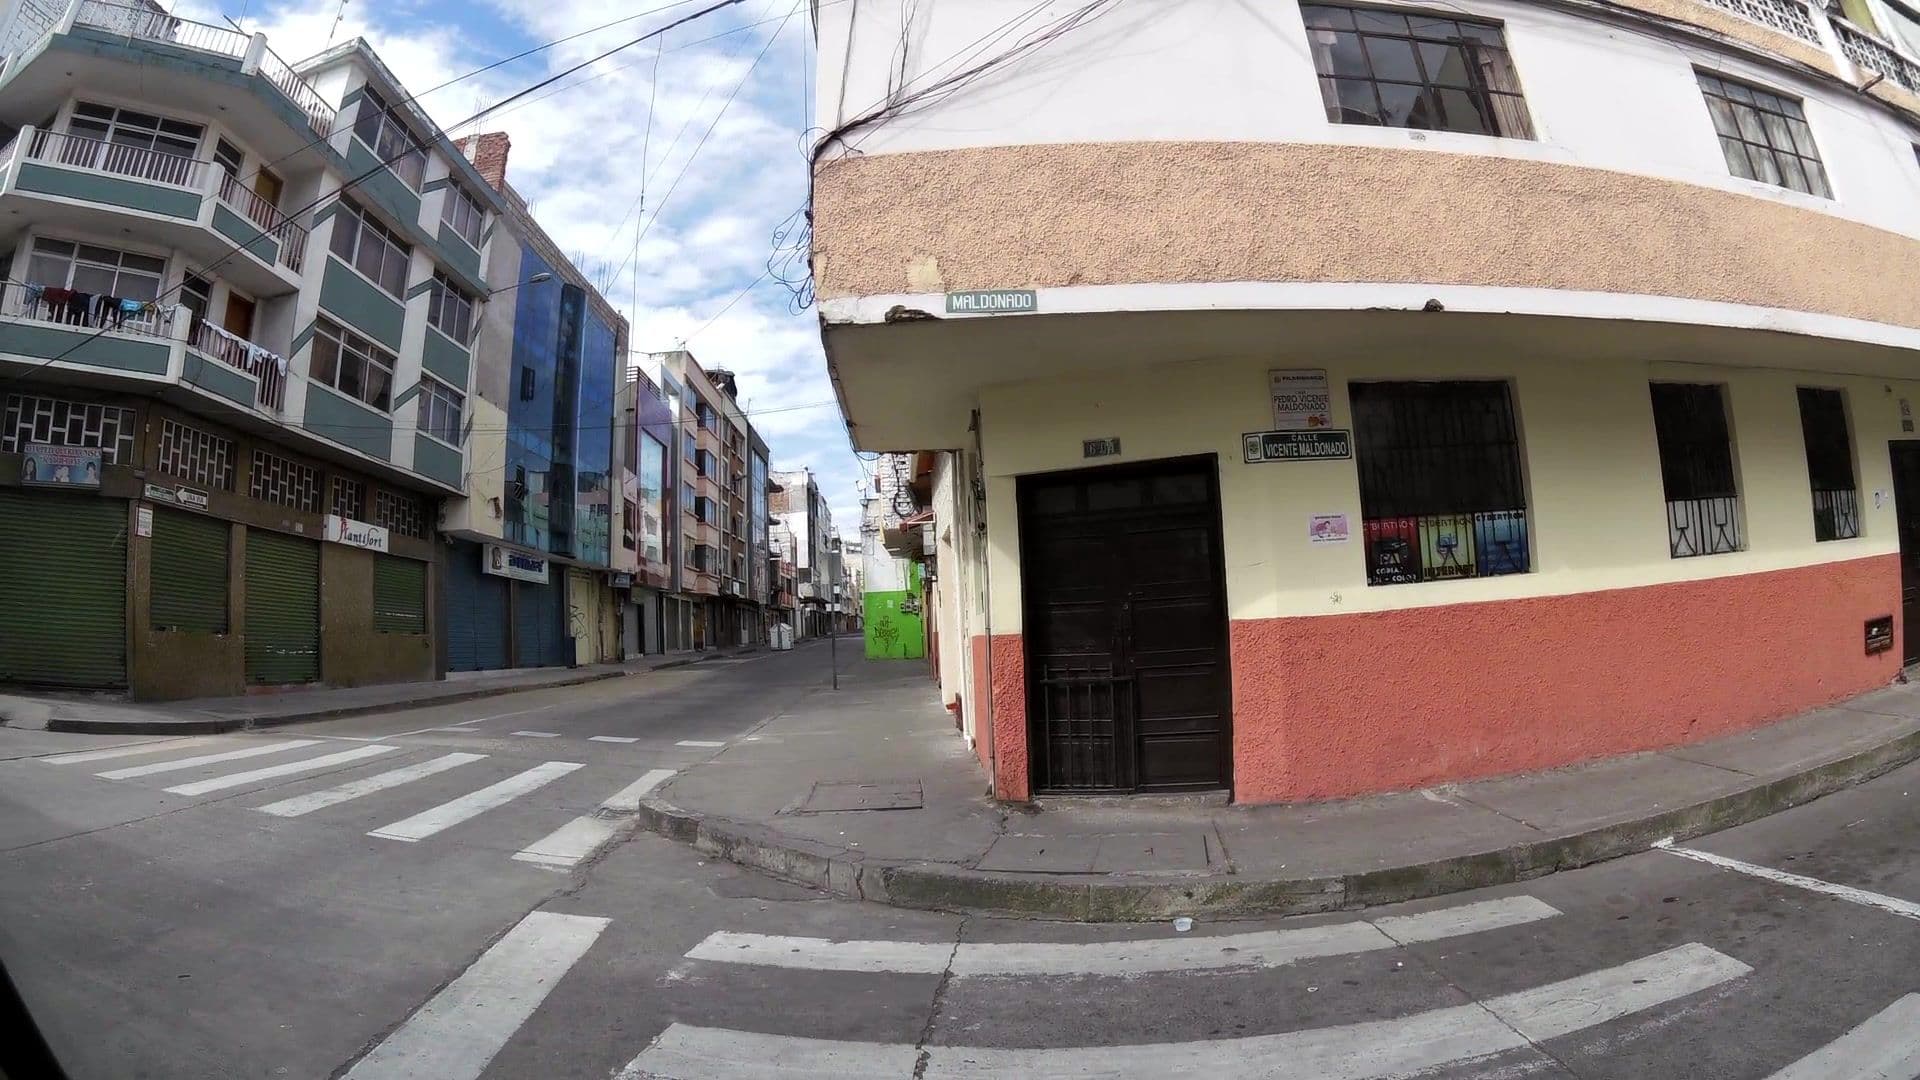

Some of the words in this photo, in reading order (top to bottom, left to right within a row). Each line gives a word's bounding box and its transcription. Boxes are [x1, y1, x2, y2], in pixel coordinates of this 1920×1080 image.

[953, 293, 1032, 310] MALDONADO
[1274, 394, 1298, 403] PEDRO
[1299, 394, 1329, 403] VICENTE
[1277, 402, 1327, 411] MALDONADO
[1291, 433, 1319, 441] CALLE
[1265, 443, 1298, 457] VICENTE
[1299, 441, 1347, 456] MALDONADO
[1476, 511, 1525, 522] CYBERTRON
[1423, 564, 1474, 578] INTERNET
